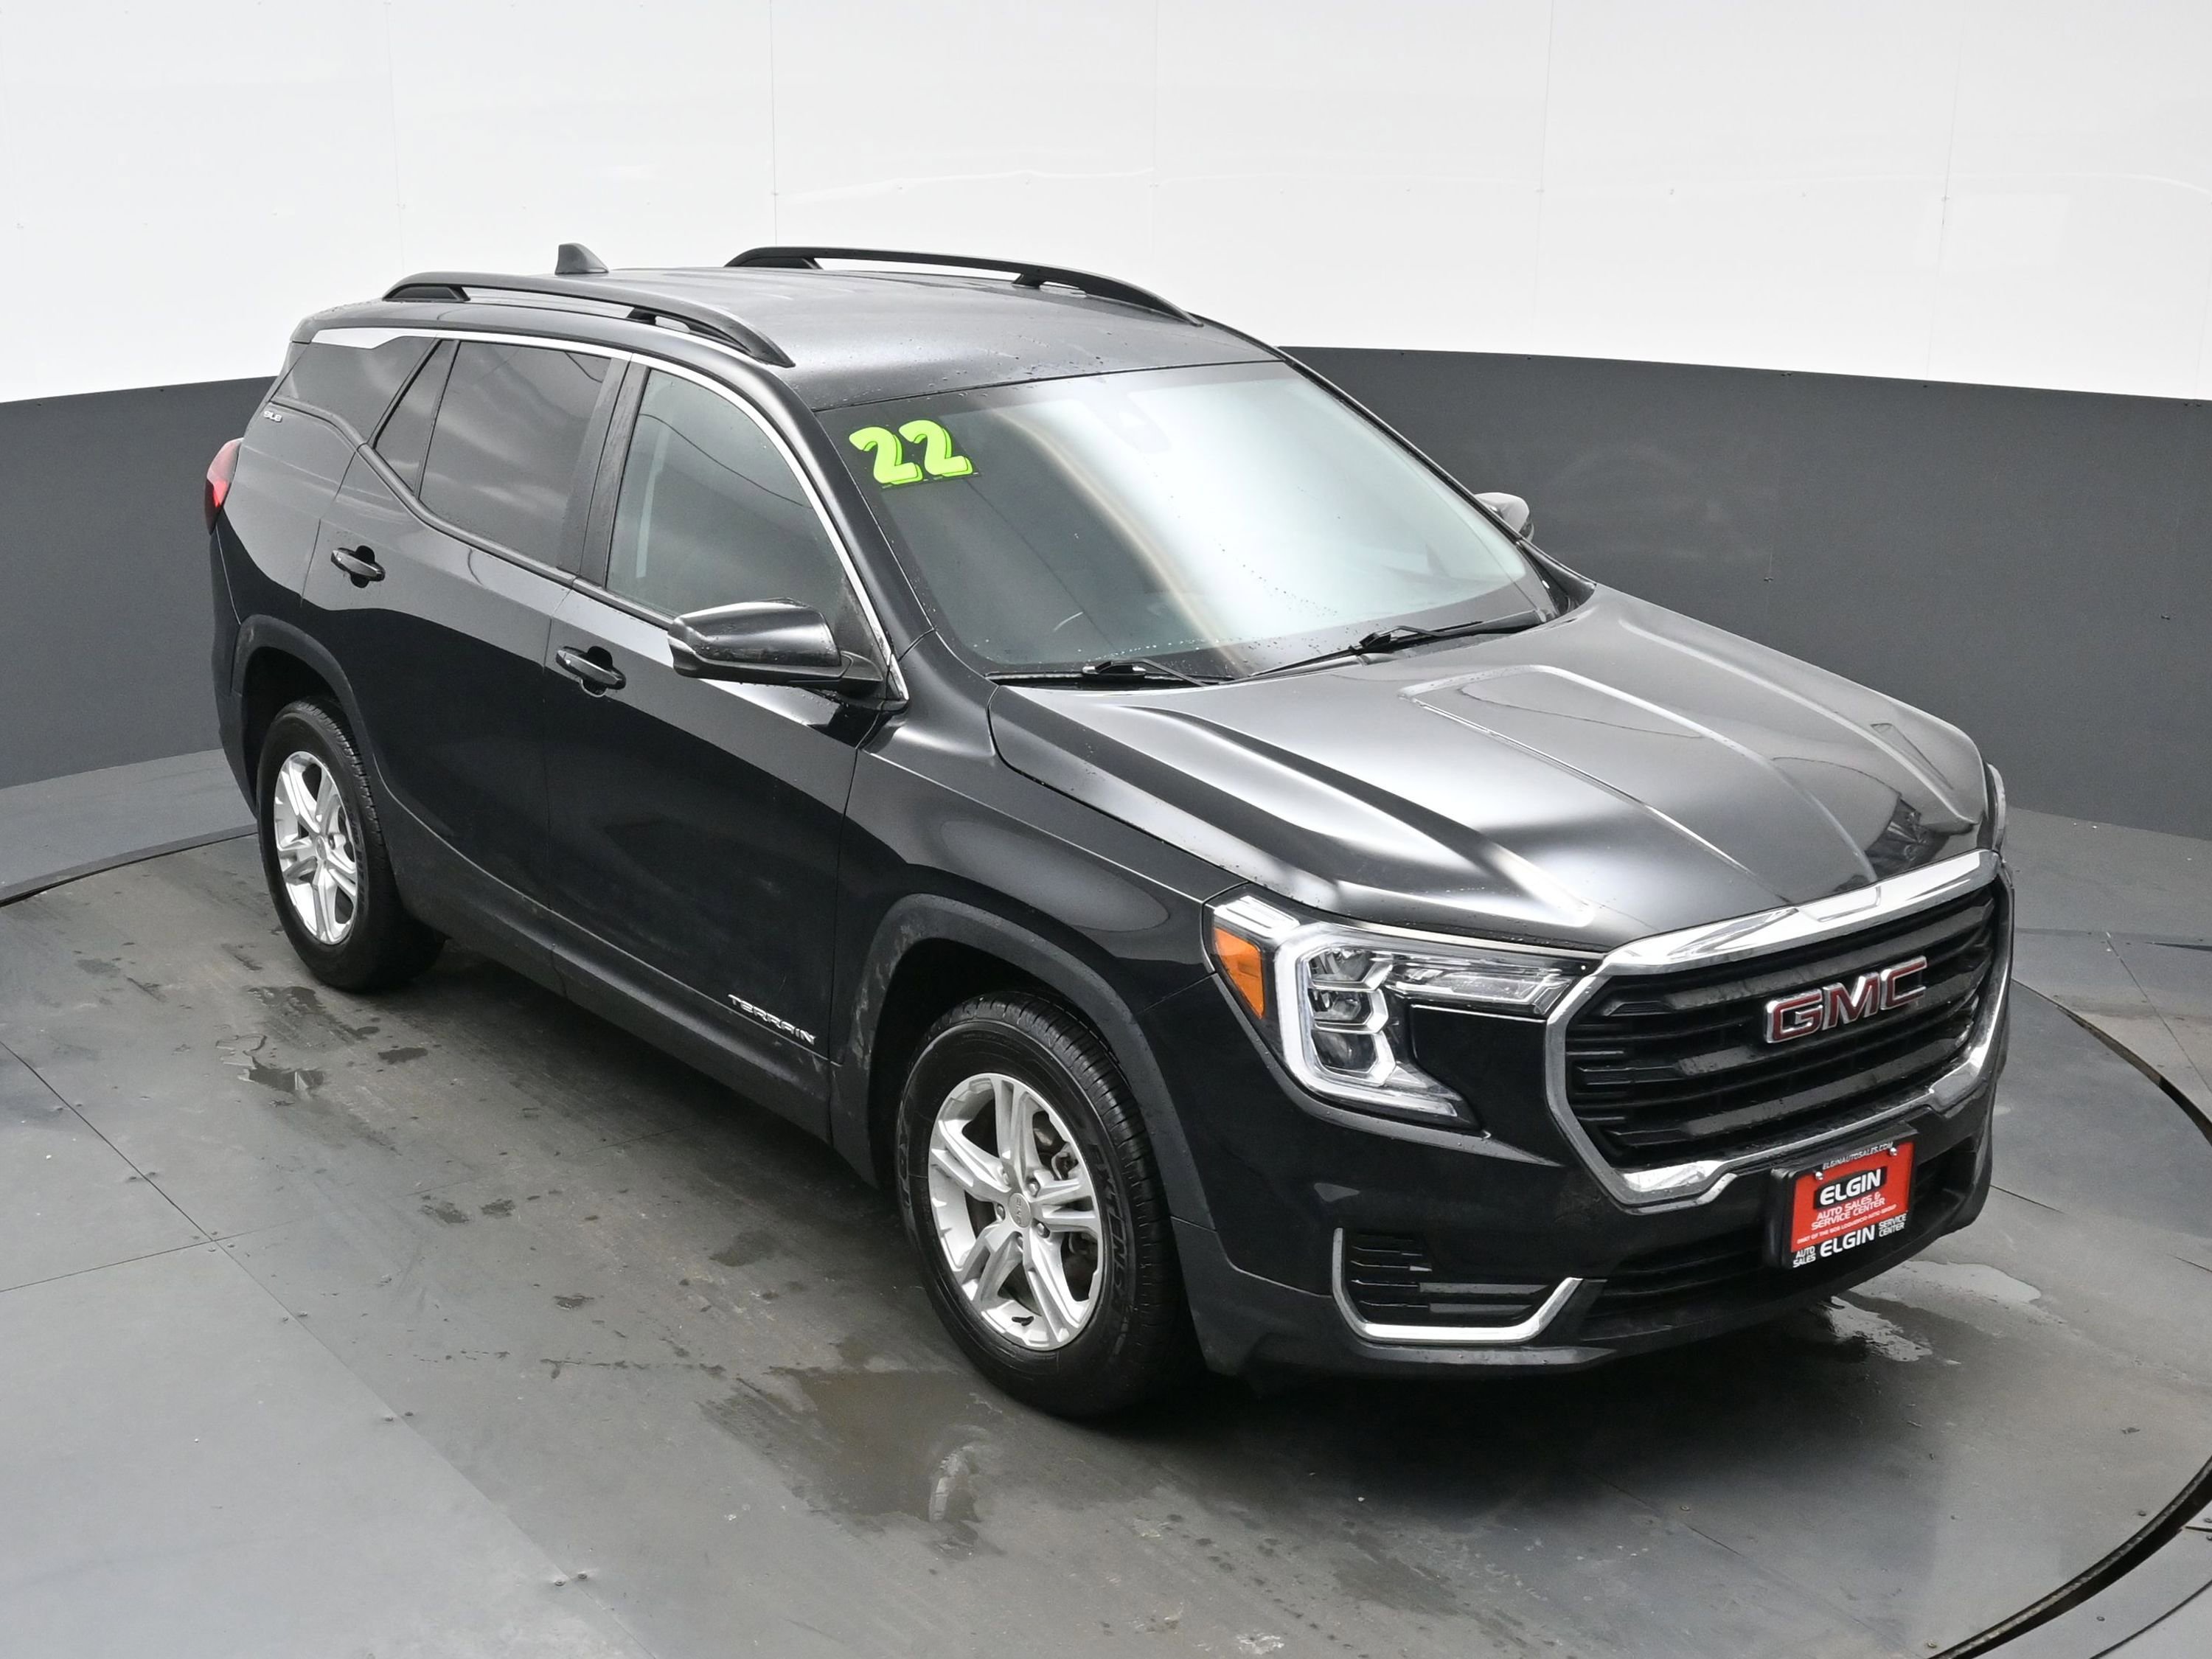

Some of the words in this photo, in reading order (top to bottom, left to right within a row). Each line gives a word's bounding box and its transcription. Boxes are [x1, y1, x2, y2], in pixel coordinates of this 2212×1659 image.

[849, 420, 973, 485] 22
[1766, 955, 1927, 1043] GMC
[728, 994, 816, 1046] TERRAIN
[1822, 1141, 1893, 1170] ELGINAUTOSALES.COM
[1820, 1169, 1882, 1206] ELGIN
[1811, 1212, 1851, 1230] SERVICE
[1852, 1197, 1885, 1216] CENTER
[1816, 1206, 1843, 1221] AUTO
[1844, 1194, 1872, 1211] SALES
[1874, 1192, 1882, 1201] &
[1879, 1214, 1907, 1230] SERVICE
[1820, 1225, 1875, 1258] ELGIN
[1879, 1222, 1905, 1237] CENTER
[1792, 1255, 1816, 1267] SALES
[1795, 1245, 1815, 1259] AUTO
